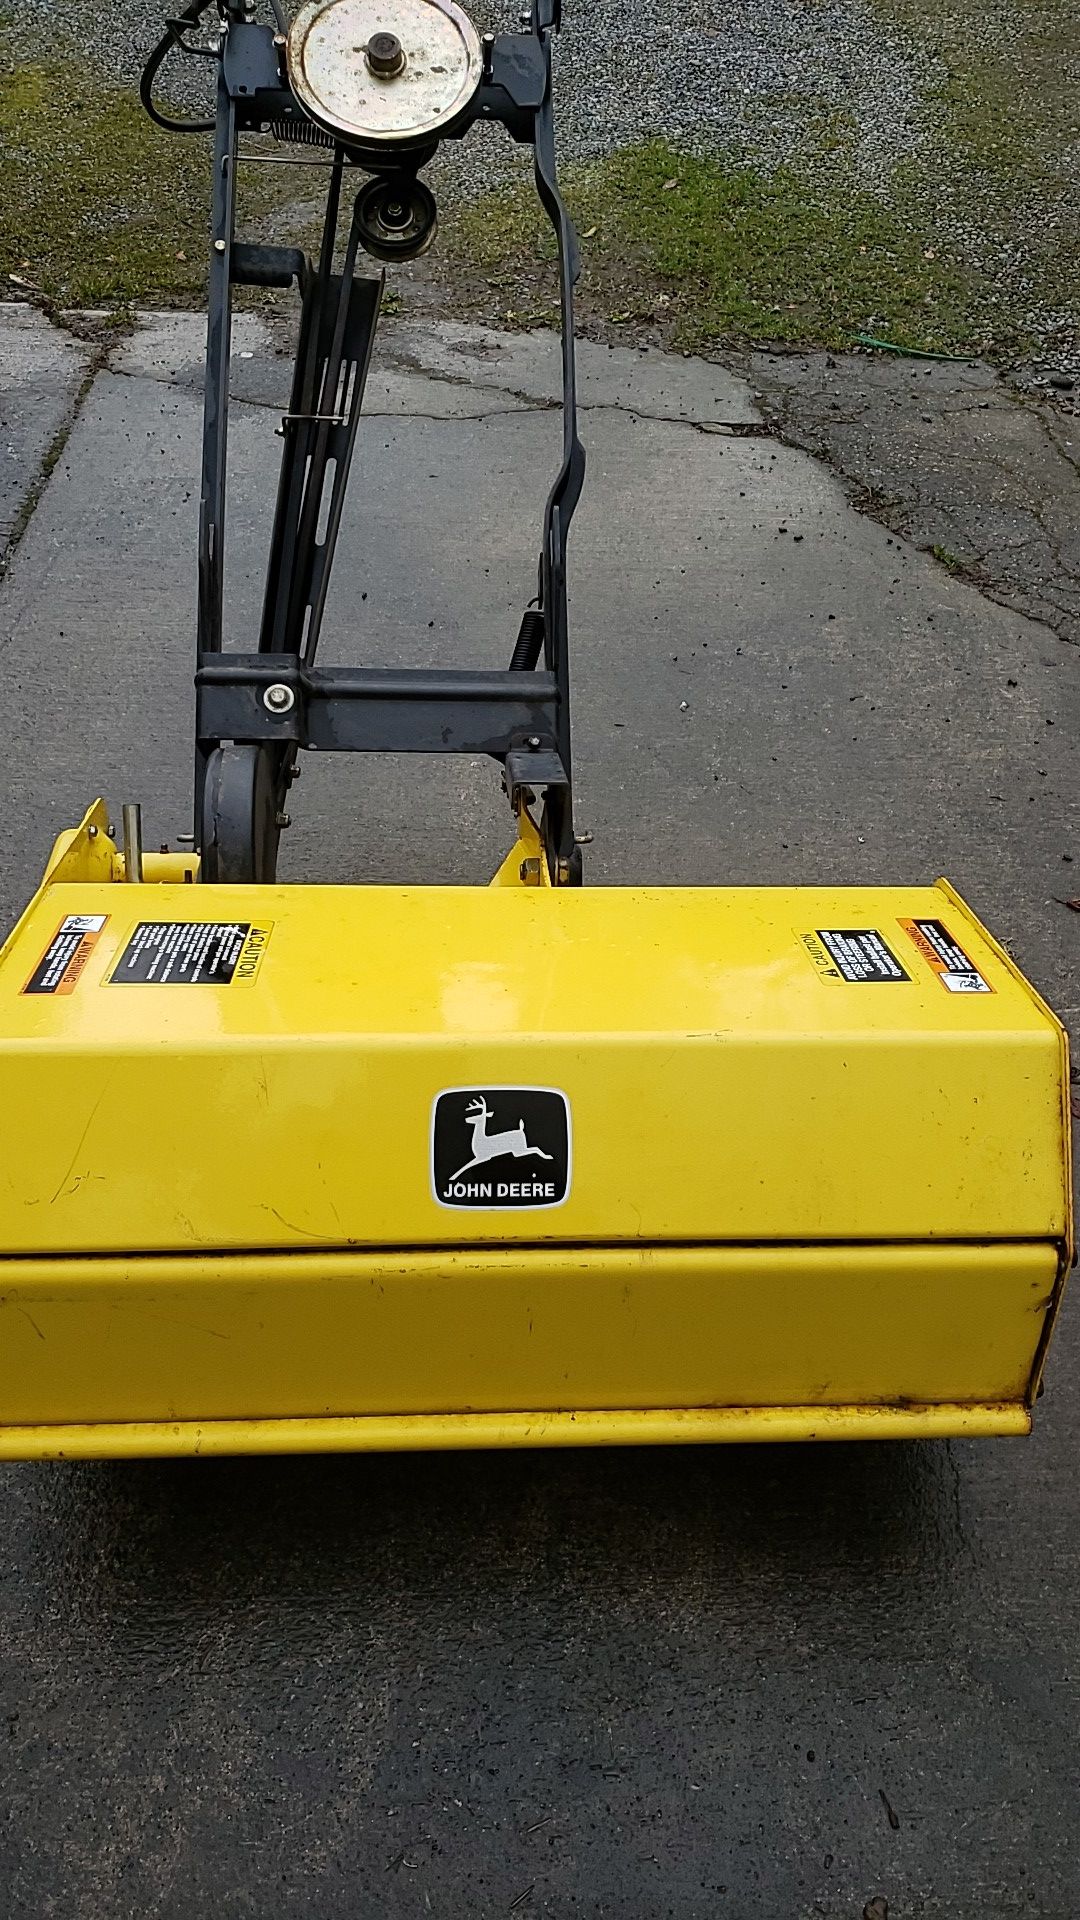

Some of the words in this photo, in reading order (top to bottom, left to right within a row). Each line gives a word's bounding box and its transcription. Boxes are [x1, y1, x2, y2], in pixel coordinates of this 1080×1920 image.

[236, 936, 265, 977] CAUTION
[799, 933, 829, 965] CAUTION
[904, 926, 937, 957] WARNING
[62, 946, 92, 982] WARNING
[850, 964, 868, 977] LOSS
[861, 963, 875, 971] OR
[443, 1182, 492, 1198] JOHN
[497, 1182, 555, 1197] DEERE
